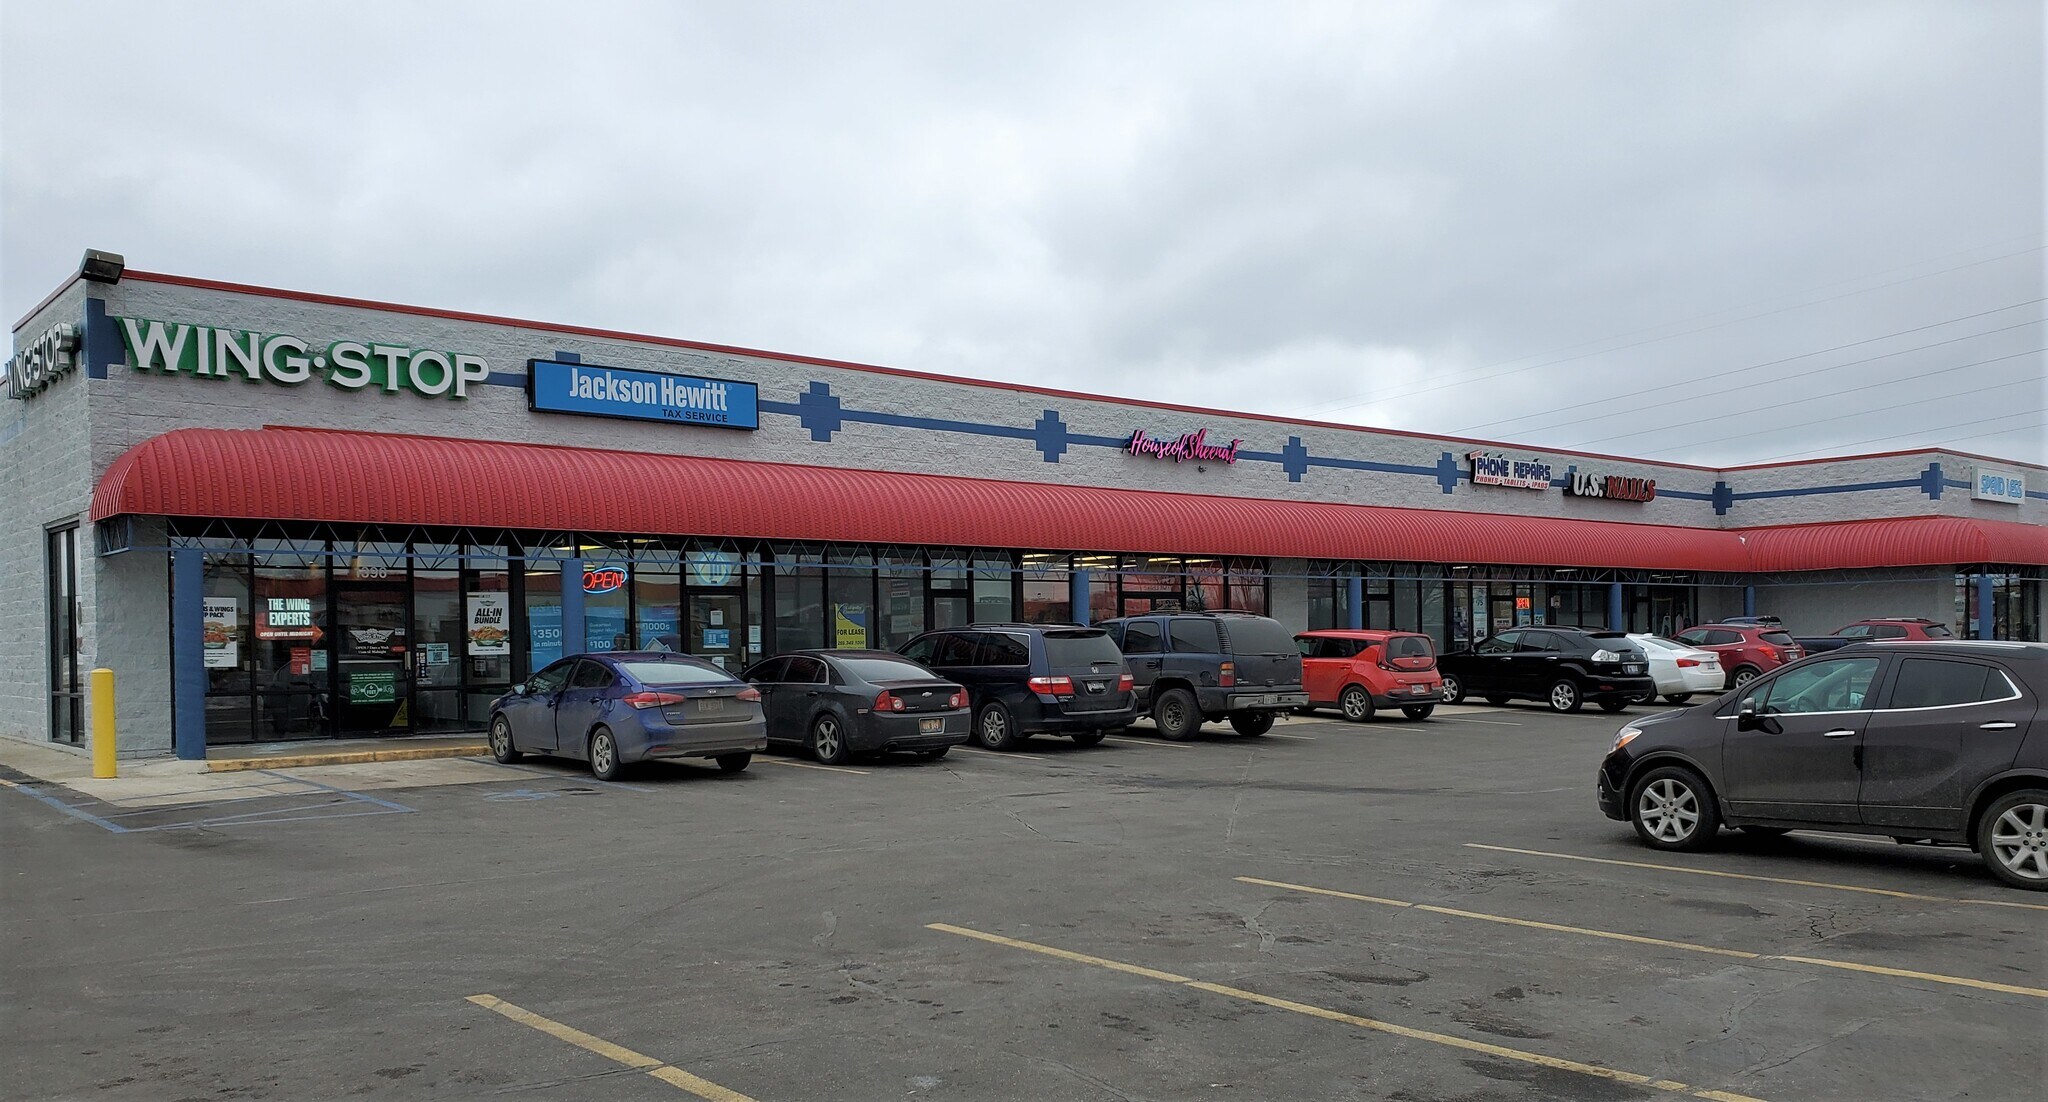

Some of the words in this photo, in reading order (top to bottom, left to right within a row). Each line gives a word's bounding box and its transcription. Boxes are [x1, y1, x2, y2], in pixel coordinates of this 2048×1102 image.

[569, 367, 657, 405] Jackson
[660, 377, 728, 412] Hewitt
[662, 408, 682, 419] TAX
[685, 412, 728, 423] SERVICE
[1476, 456, 1510, 477] PHONE
[1513, 461, 1552, 482] REPAIRS
[1475, 475, 1499, 484] PHONES
[1981, 474, 2005, 496] SPEND
[2006, 478, 2023, 499] LESS
[1572, 472, 1604, 498] U.S.
[1605, 475, 1657, 503] NAILS
[582, 571, 624, 589] OPEN
[267, 598, 285, 611] THE
[286, 598, 310, 611] WING
[1516, 597, 1530, 609] OPEN
[269, 611, 310, 626] EXPERTS
[476, 607, 503, 617] ALL-IN
[474, 616, 501, 624] BUNDLE
[848, 628, 865, 636] LEASE
[590, 640, 611, 649] $100
